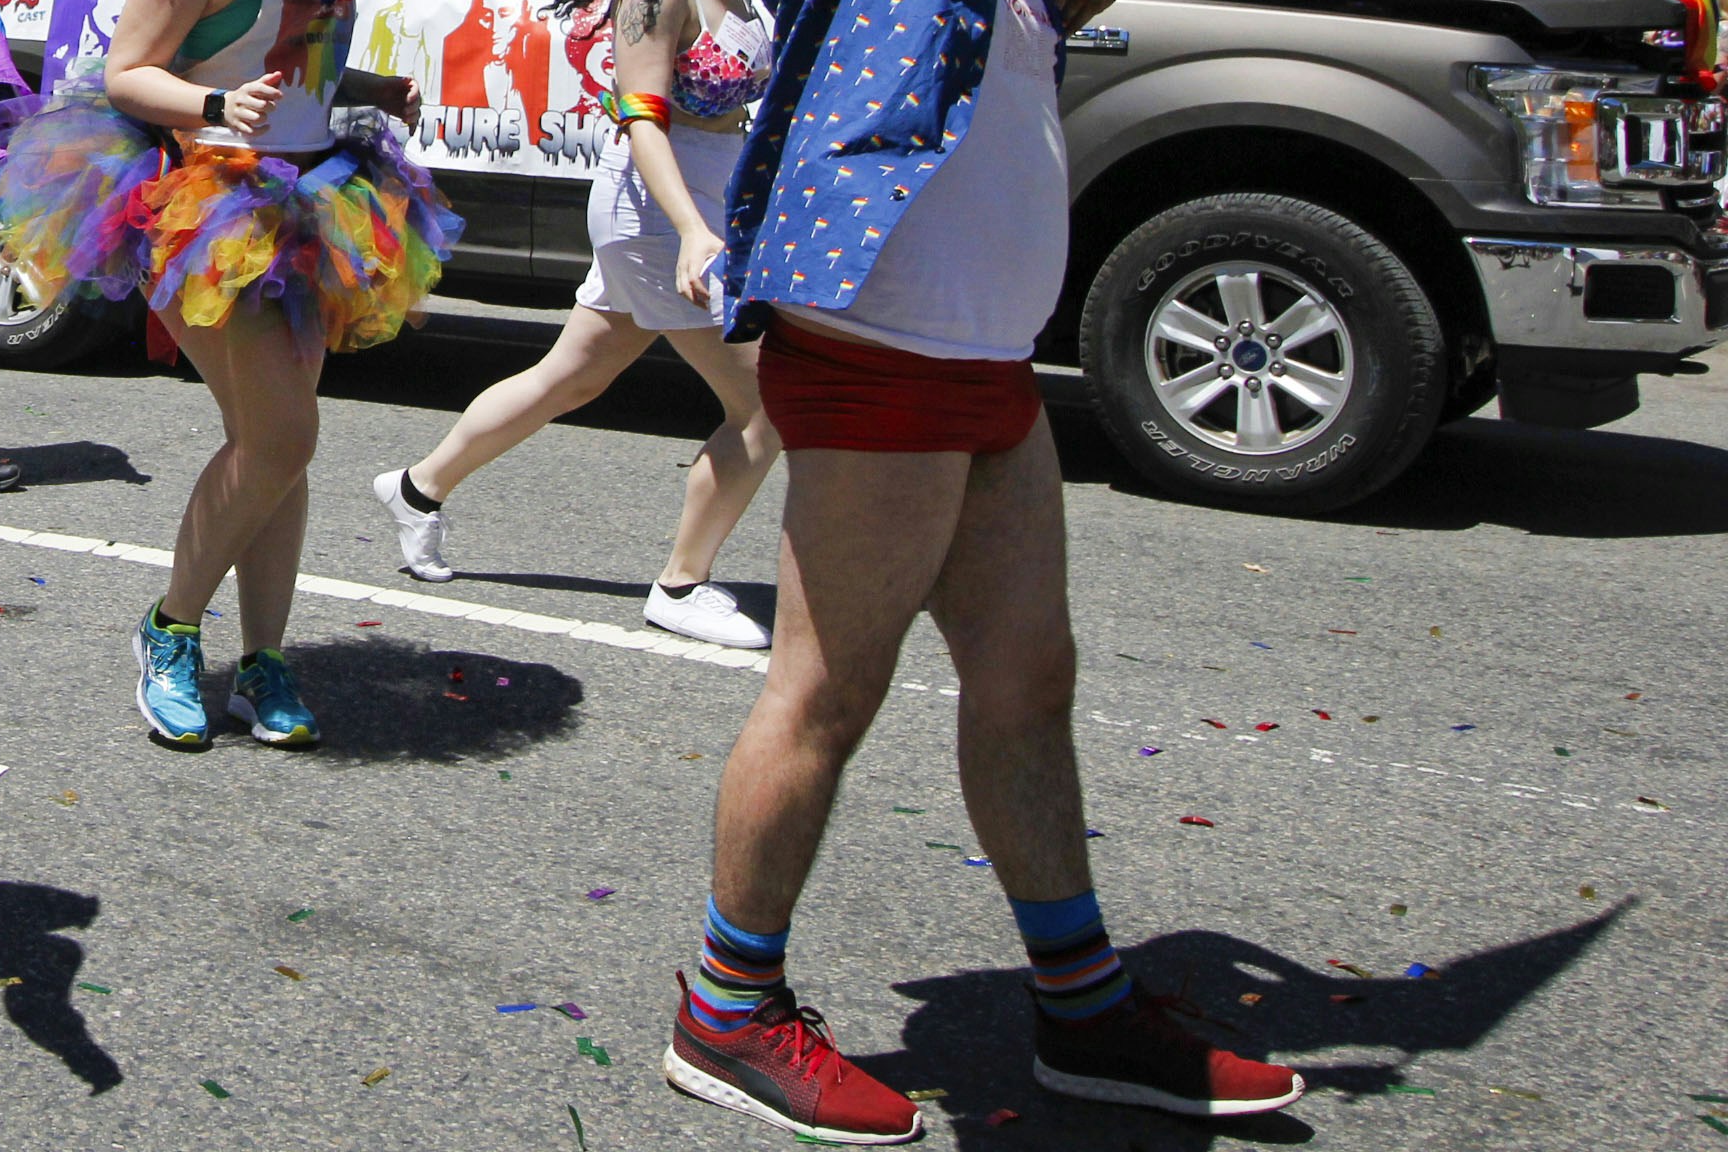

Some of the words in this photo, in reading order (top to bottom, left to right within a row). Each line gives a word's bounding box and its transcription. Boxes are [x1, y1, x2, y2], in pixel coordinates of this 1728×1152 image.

[17, 10, 46, 23] CAST
[1137, 232, 1354, 298] GOODYEAR
[1141, 419, 1357, 483] WRANGLER
